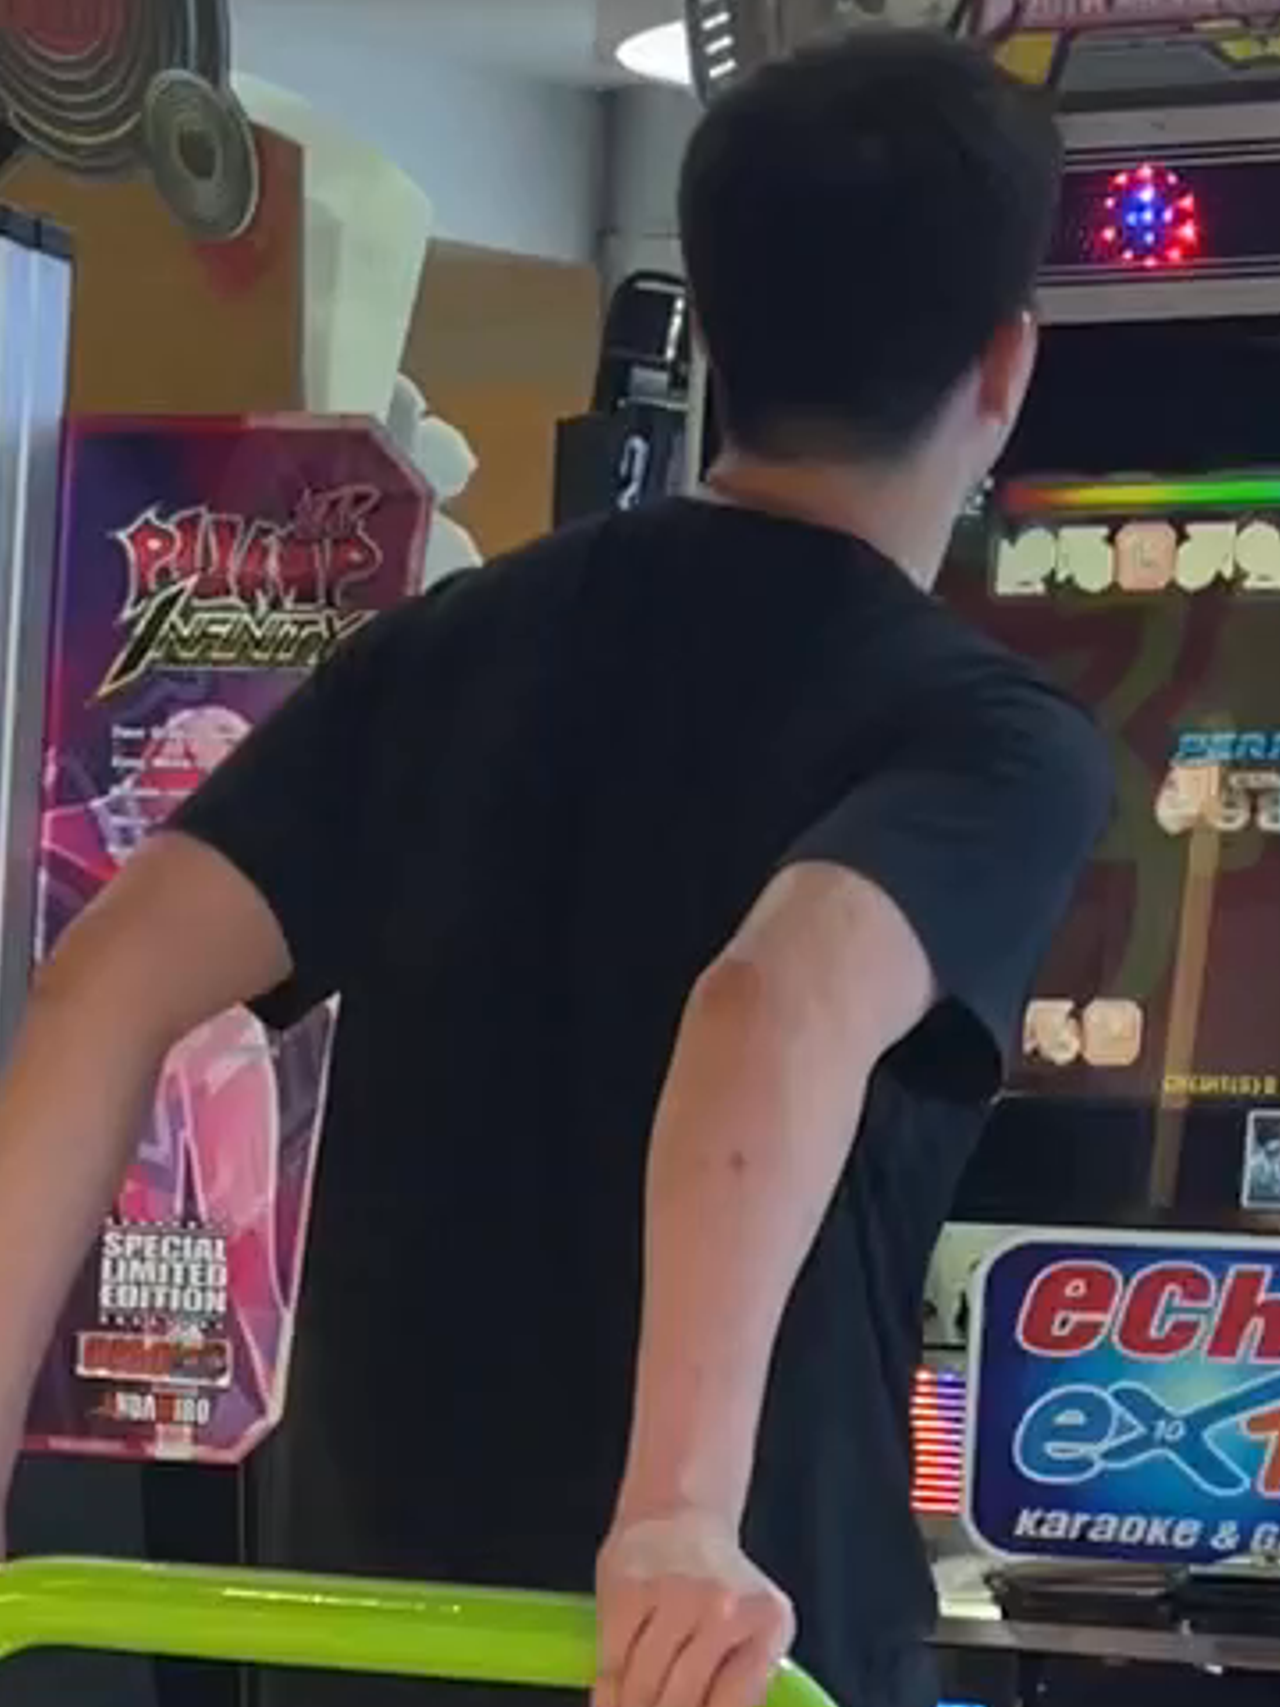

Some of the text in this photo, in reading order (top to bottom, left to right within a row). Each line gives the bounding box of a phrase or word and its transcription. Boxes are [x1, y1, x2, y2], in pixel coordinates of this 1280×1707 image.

[102, 1232, 227, 1262] SPECIAL
[101, 1257, 228, 1287] LIMITED
[99, 1283, 228, 1312] EDITION
[1152, 1417, 1187, 1442] 10
[1210, 1520, 1239, 1550] &
